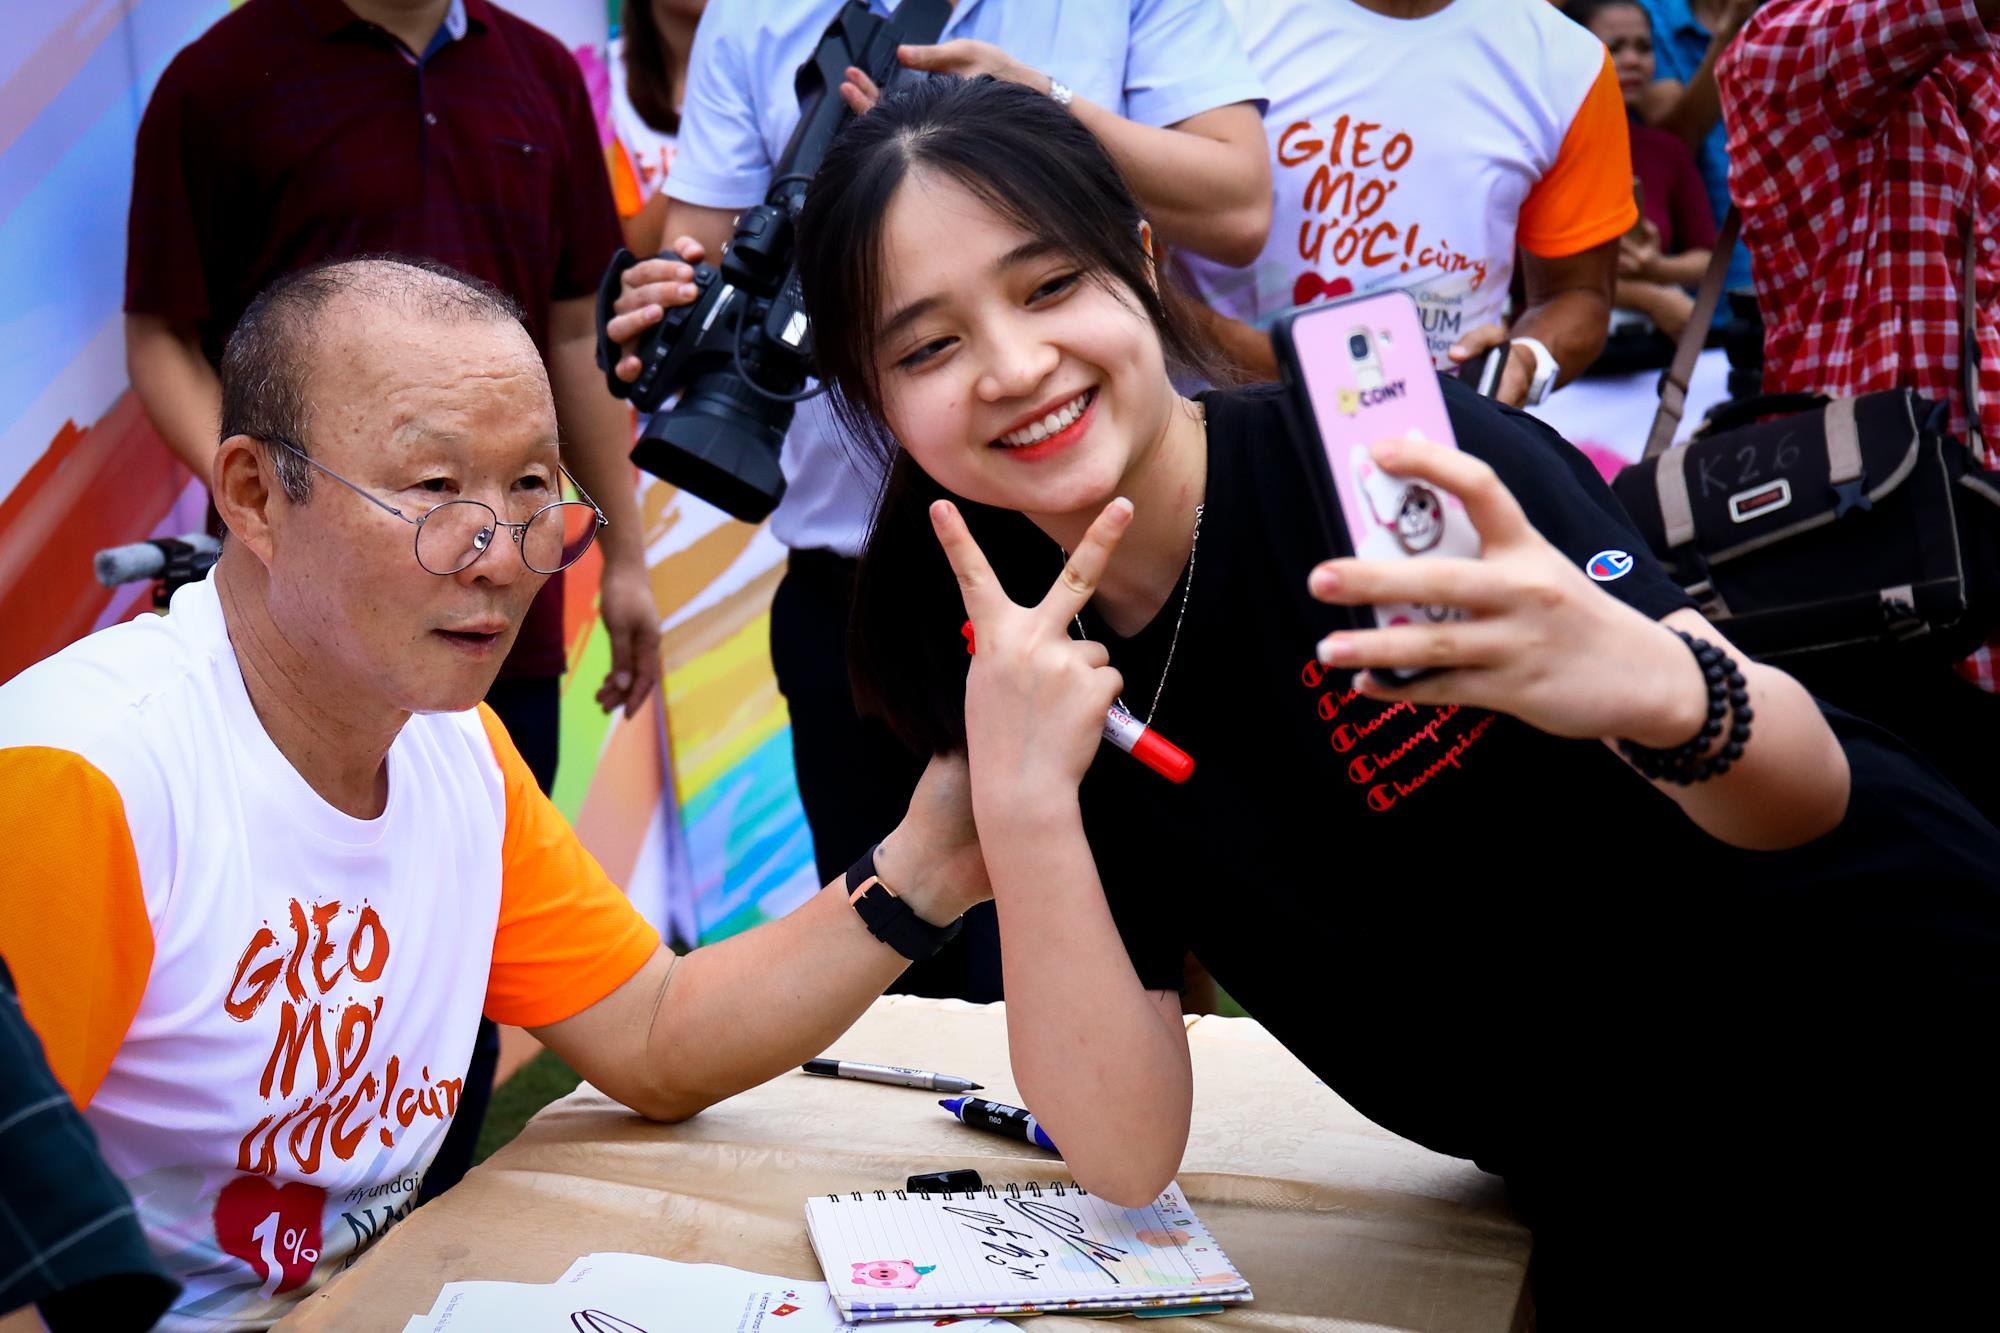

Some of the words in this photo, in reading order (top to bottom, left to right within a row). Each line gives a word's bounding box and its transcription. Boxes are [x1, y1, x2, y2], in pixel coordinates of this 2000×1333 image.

[1277, 113, 1414, 172] GIEO
[1416, 306, 1462, 335] UM
[1359, 381, 1406, 407] CONY
[223, 897, 390, 1022] GIEO
[344, 1171, 419, 1204] Hyundai
[252, 1211, 319, 1300] 1%
